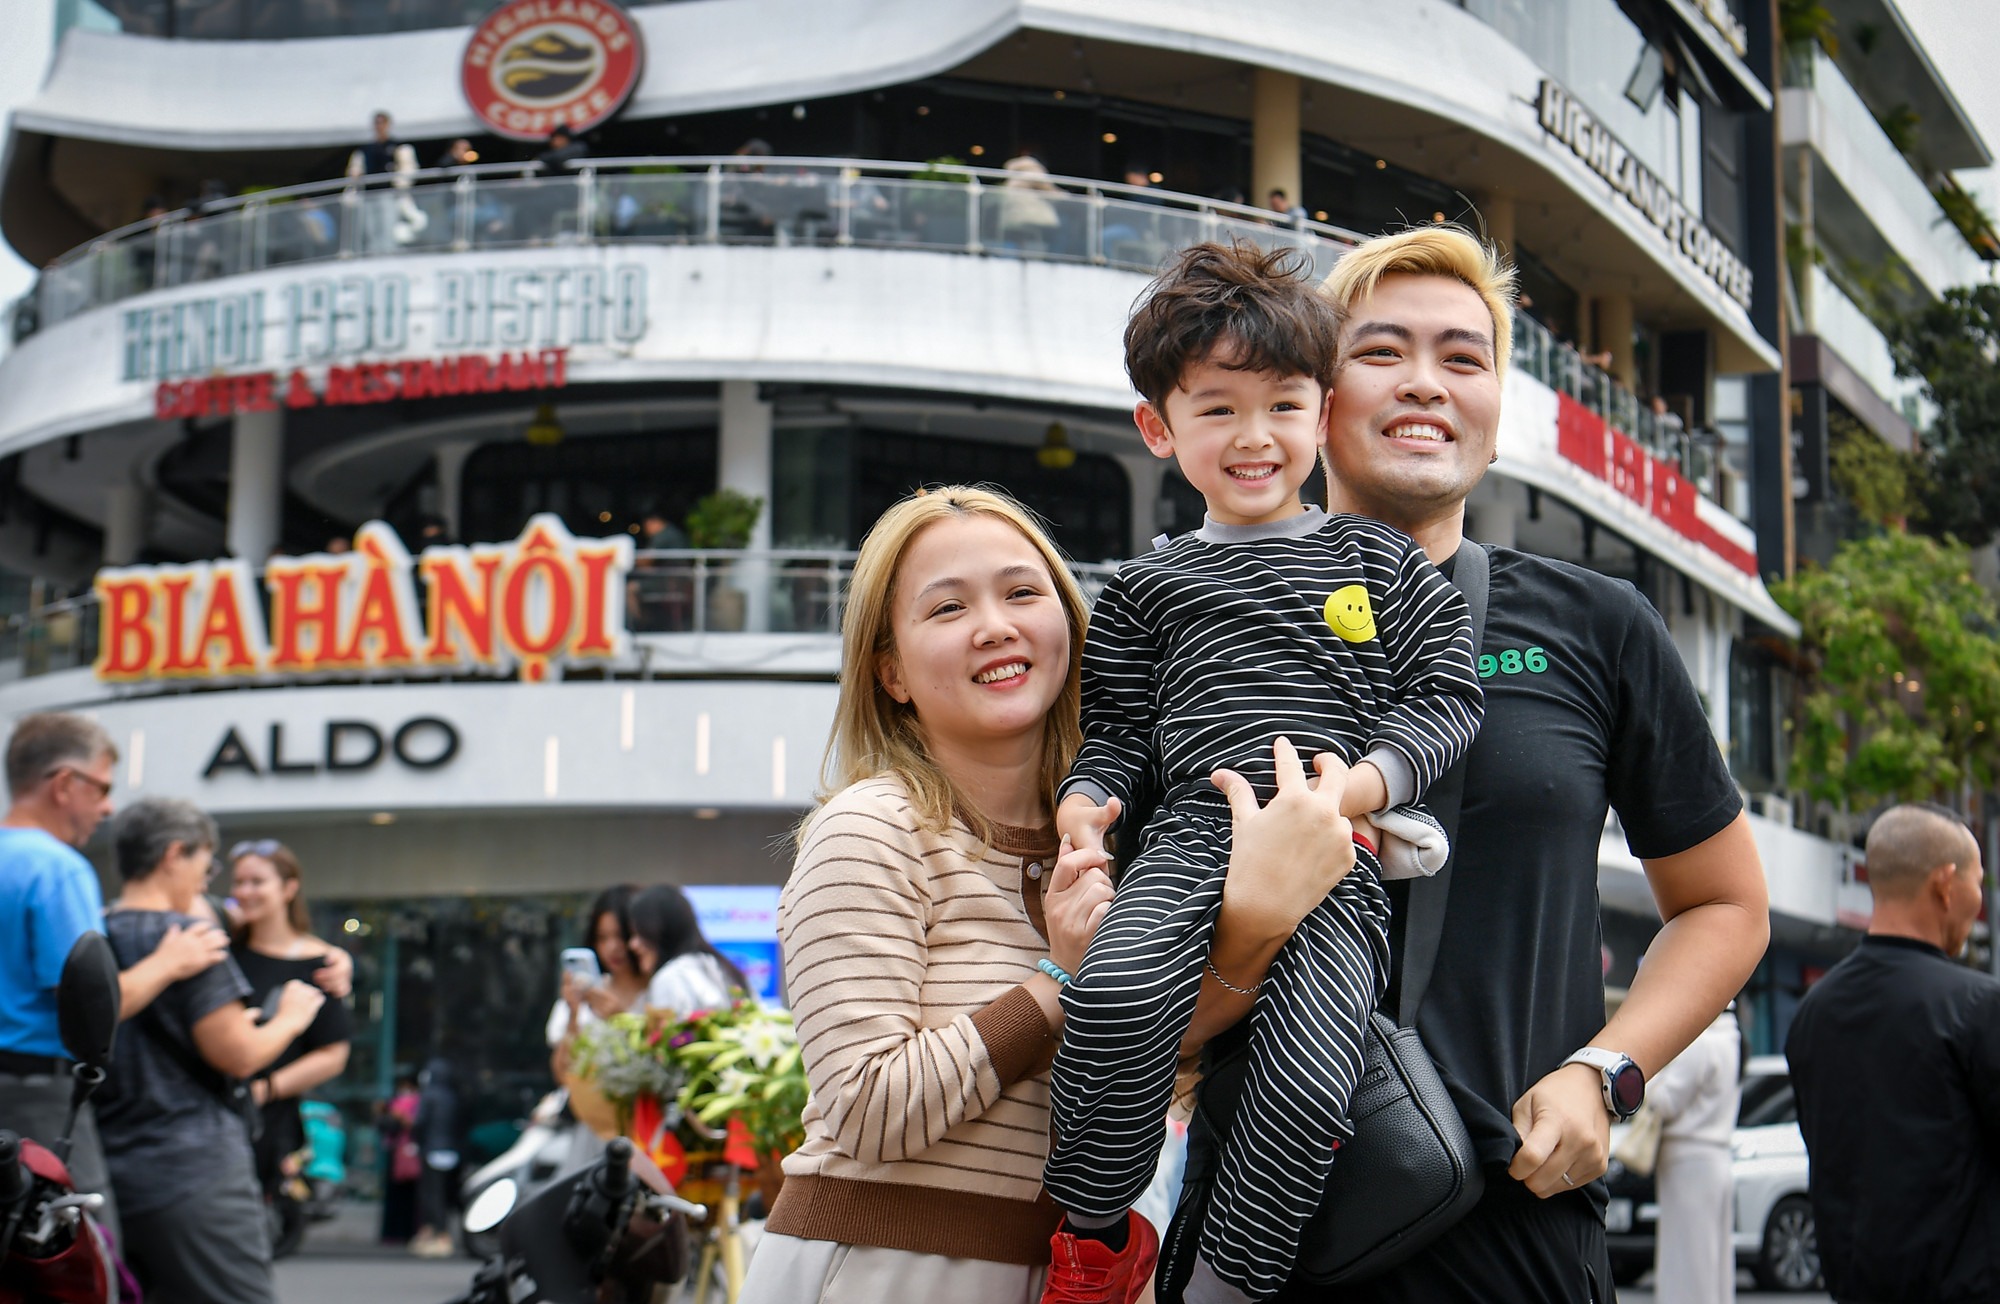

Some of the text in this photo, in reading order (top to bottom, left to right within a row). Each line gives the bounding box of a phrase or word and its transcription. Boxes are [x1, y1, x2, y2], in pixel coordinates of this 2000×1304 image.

[468, 0, 628, 67] HIGHLANDS
[487, 89, 609, 131] COFFEE
[1540, 80, 1753, 312] HIGHLANDS COFFEE
[282, 271, 409, 358] 1930
[436, 263, 648, 348] BISTRO
[156, 373, 279, 420] COFFEE
[325, 348, 569, 405] RESTAURANT
[97, 525, 617, 682] BIA HÀ NỘI
[201, 715, 460, 777] ALDO
